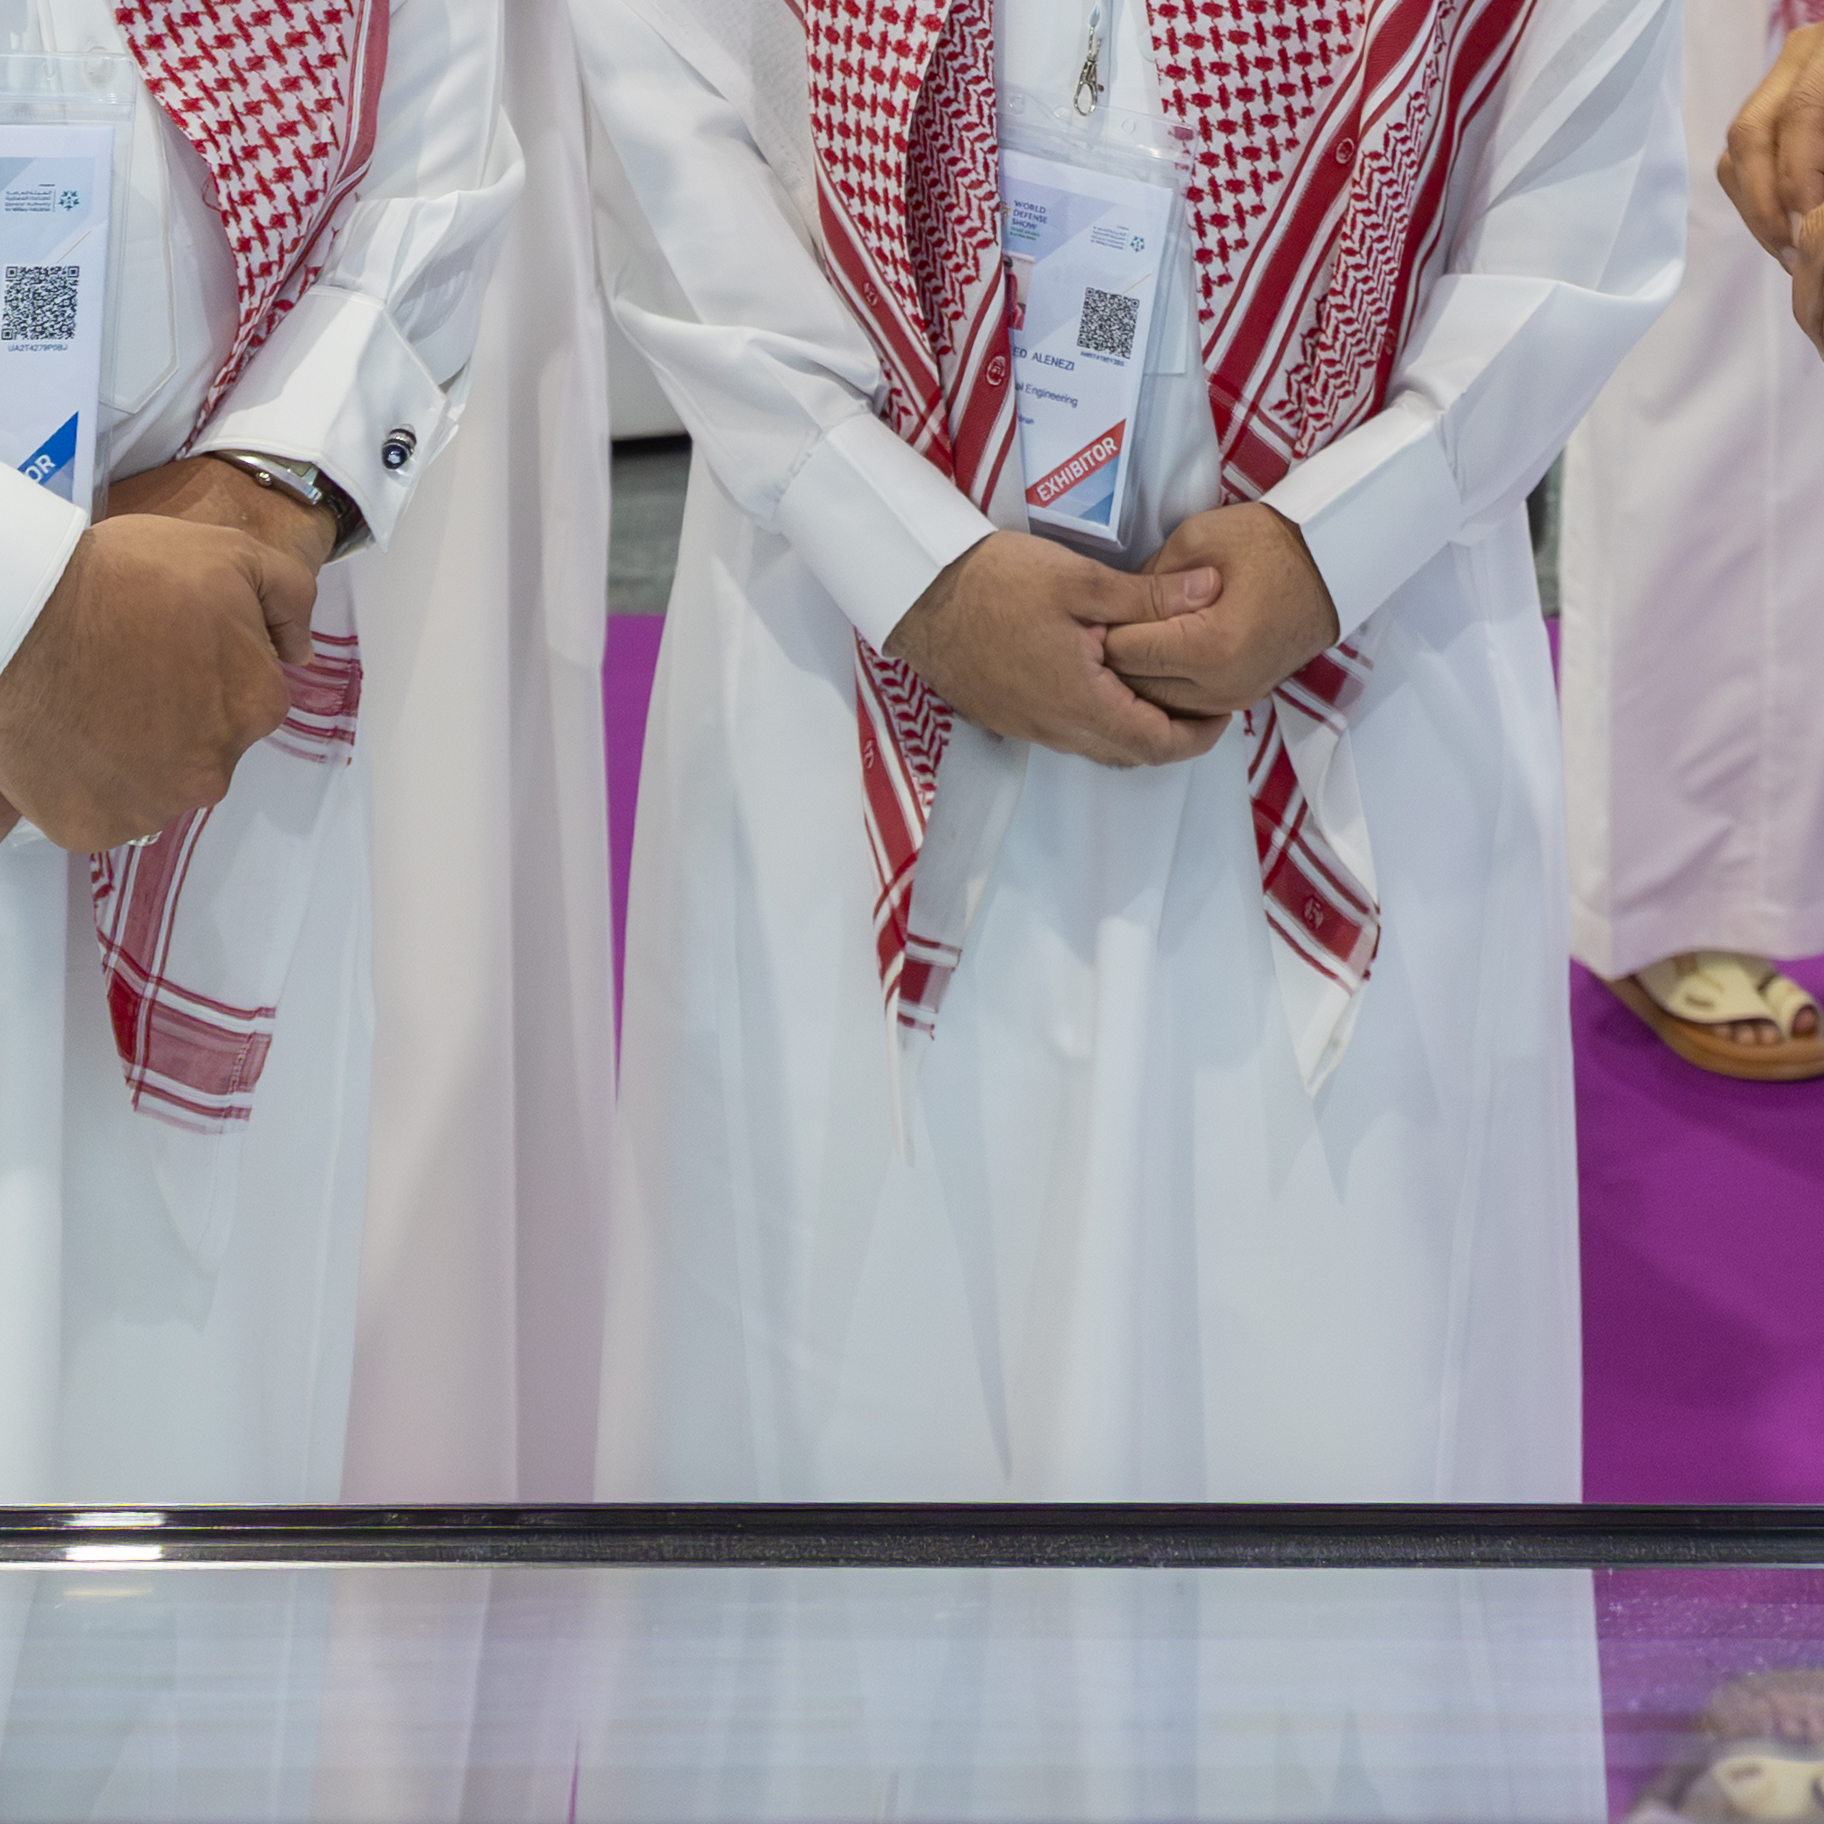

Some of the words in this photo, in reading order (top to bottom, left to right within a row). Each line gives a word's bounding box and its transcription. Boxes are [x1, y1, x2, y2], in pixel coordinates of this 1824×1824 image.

[1013, 200, 1047, 215] WORLD
[1011, 218, 1038, 230] SHOW
[1013, 209, 1048, 224] DEFENSE
[1031, 352, 1075, 372] ALENEZI
[1025, 383, 1079, 409] Engineering
[1036, 436, 1119, 502] EXHIBITOR
